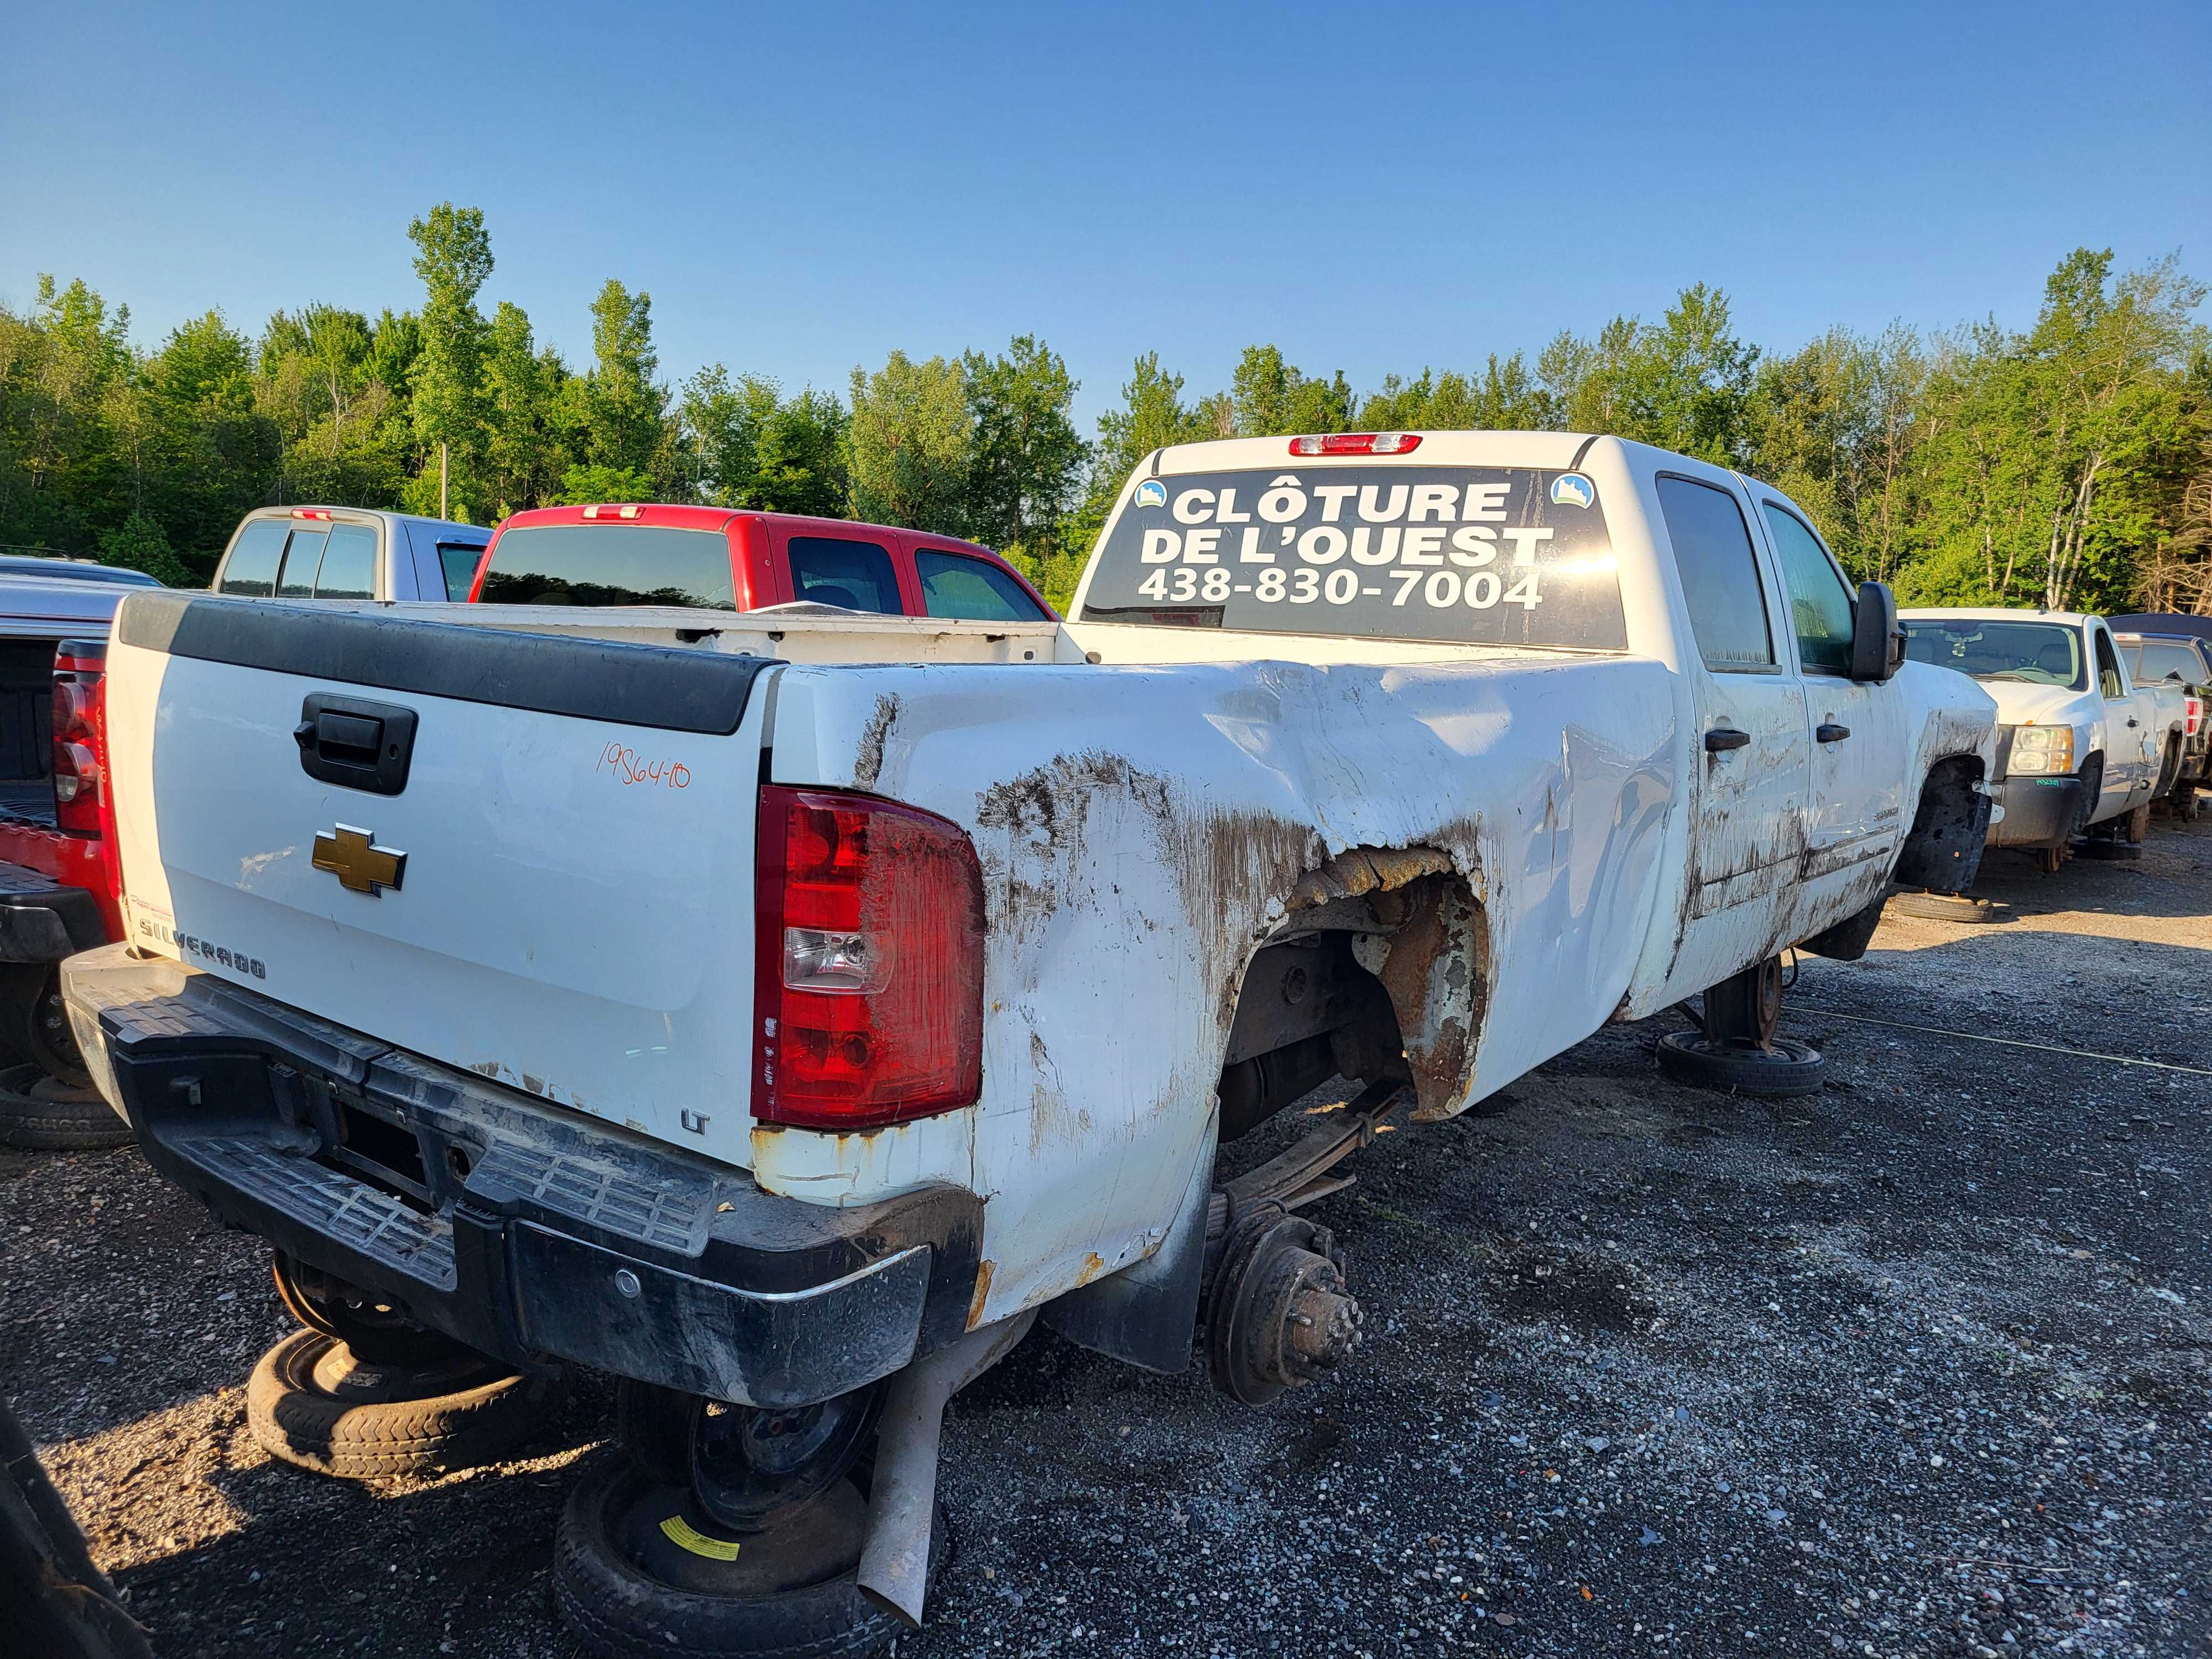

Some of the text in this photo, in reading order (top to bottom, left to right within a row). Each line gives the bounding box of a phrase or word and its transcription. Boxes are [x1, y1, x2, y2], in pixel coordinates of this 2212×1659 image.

[1172, 476, 1511, 525] CLÔTURE
[1141, 526, 1554, 567] DE L'OUEST
[1138, 567, 1543, 611] 438-830-7004
[139, 917, 265, 979] SILVERADO
[681, 1107, 710, 1136] LT
